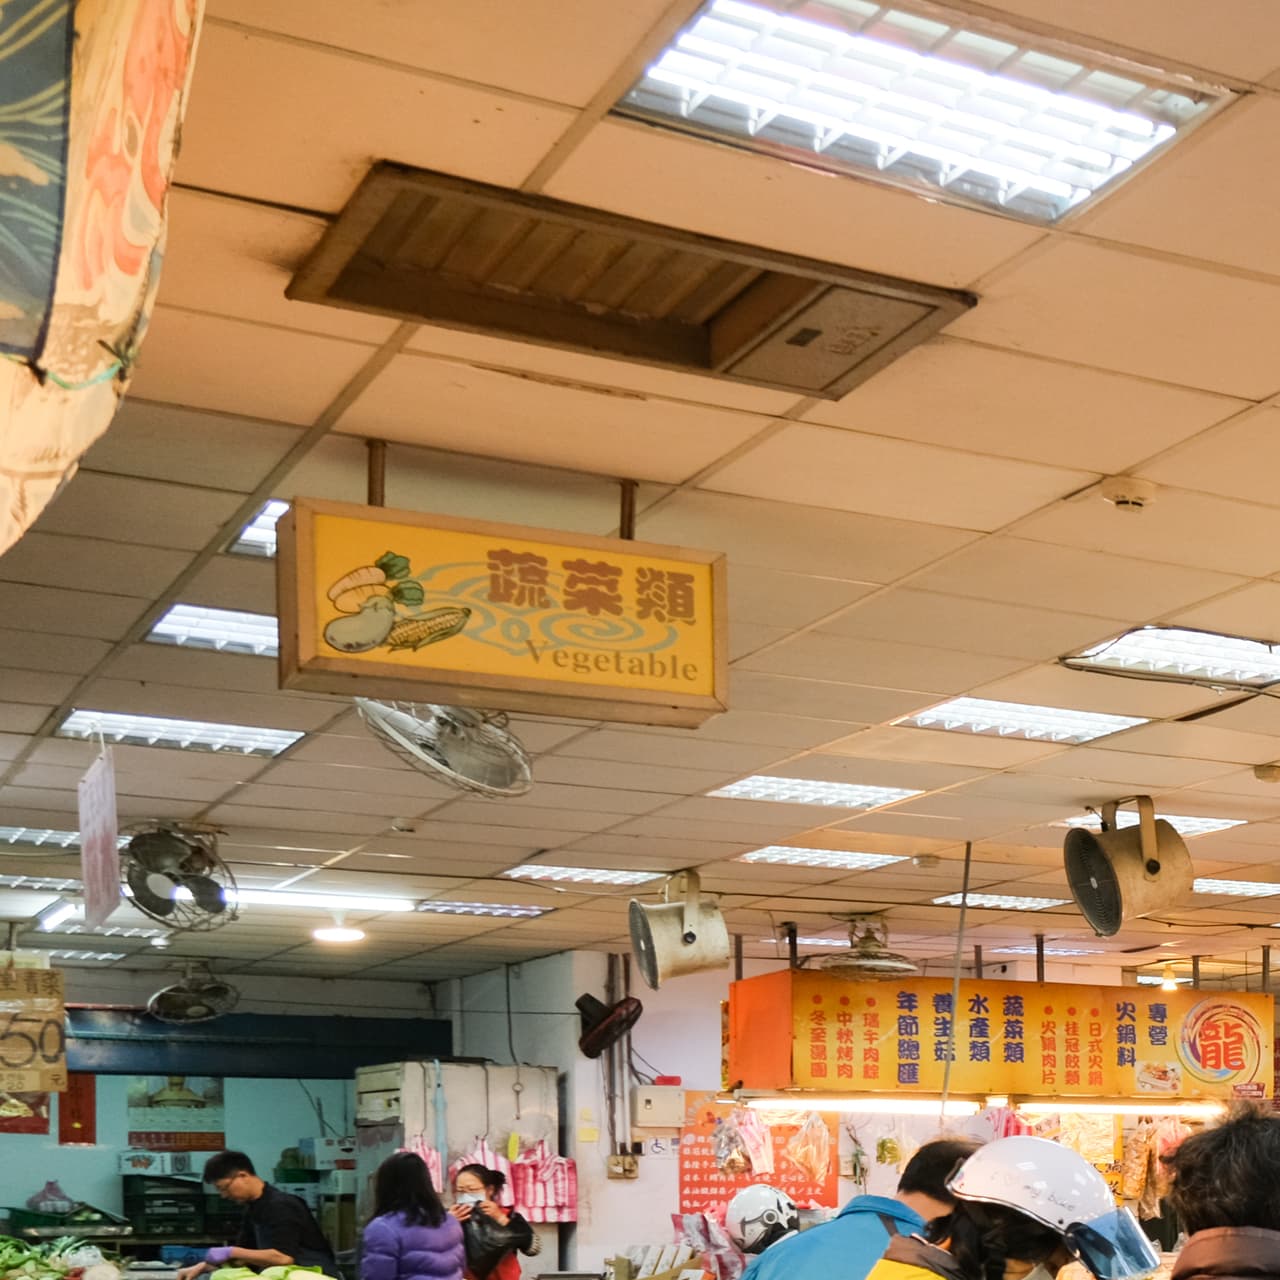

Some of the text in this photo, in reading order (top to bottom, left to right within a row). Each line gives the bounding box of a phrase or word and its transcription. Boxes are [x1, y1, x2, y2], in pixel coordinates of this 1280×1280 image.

[487, 549, 696, 626] 蔬菜類
[525, 639, 699, 682] Vegetable
[835, 1011, 854, 1080] 中秋烤肉
[968, 993, 991, 1063] 水產類
[1002, 994, 1025, 1064] 蔬菜類
[1040, 1020, 1057, 1086] 火鍋肉片
[1087, 1021, 1104, 1087] 日式火鍋
[1115, 1001, 1137, 1068] 火鍋料
[1147, 1002, 1168, 1047] 專營
[1198, 1020, 1247, 1071] 龍
